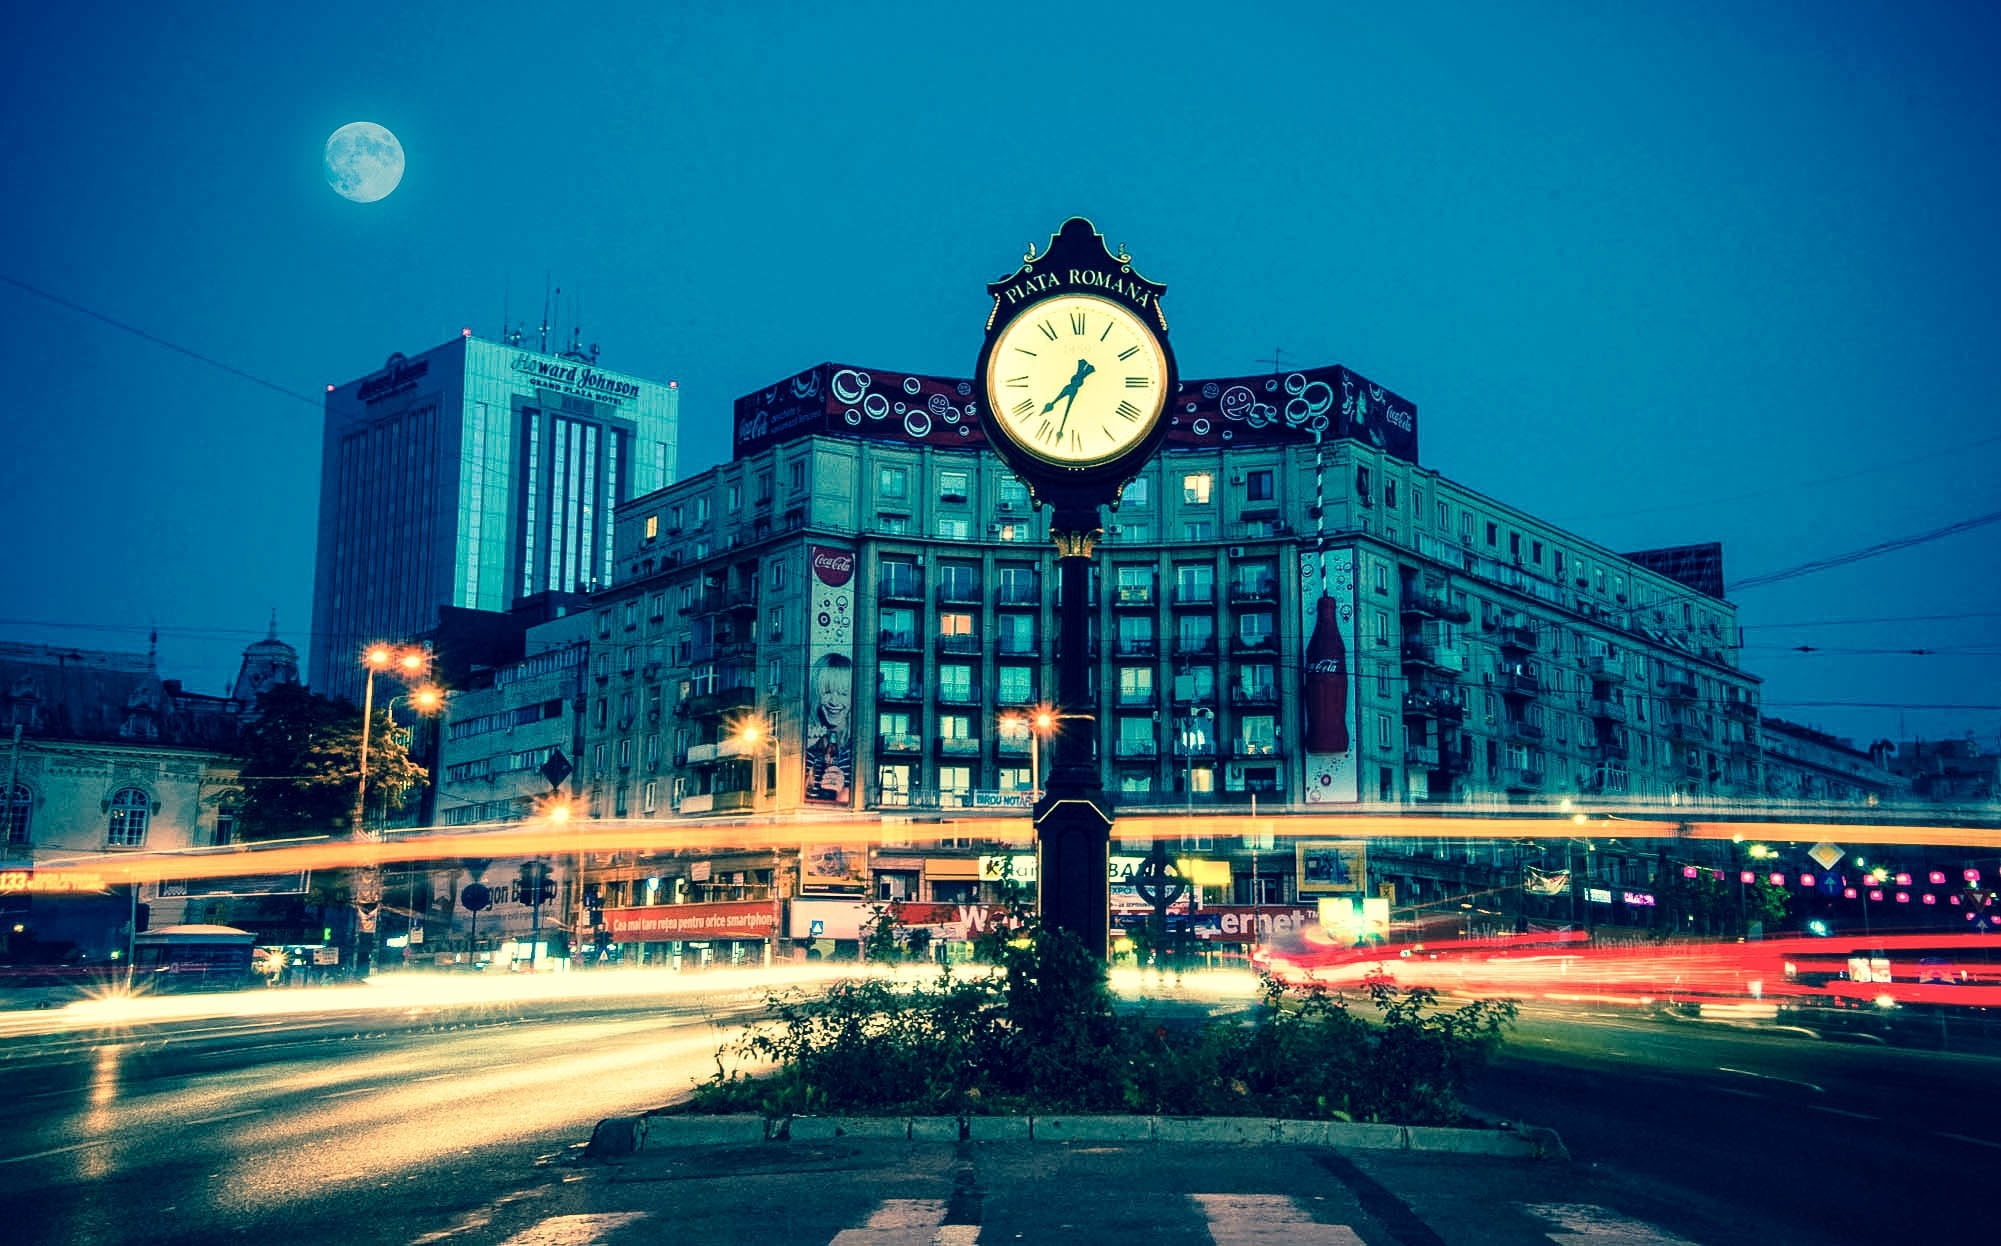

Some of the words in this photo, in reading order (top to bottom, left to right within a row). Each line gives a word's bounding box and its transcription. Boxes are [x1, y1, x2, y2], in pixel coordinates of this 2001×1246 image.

[511, 353, 577, 379] Howard
[577, 367, 640, 397] Johnson
[529, 378, 561, 392] GRAND
[563, 386, 593, 398] PLAZA
[595, 393, 622, 405] HOTEL
[613, 919, 627, 932] Cea
[628, 917, 641, 931] mai
[642, 918, 658, 931] tare
[677, 915, 705, 932] pentru
[705, 913, 726, 928] orice
